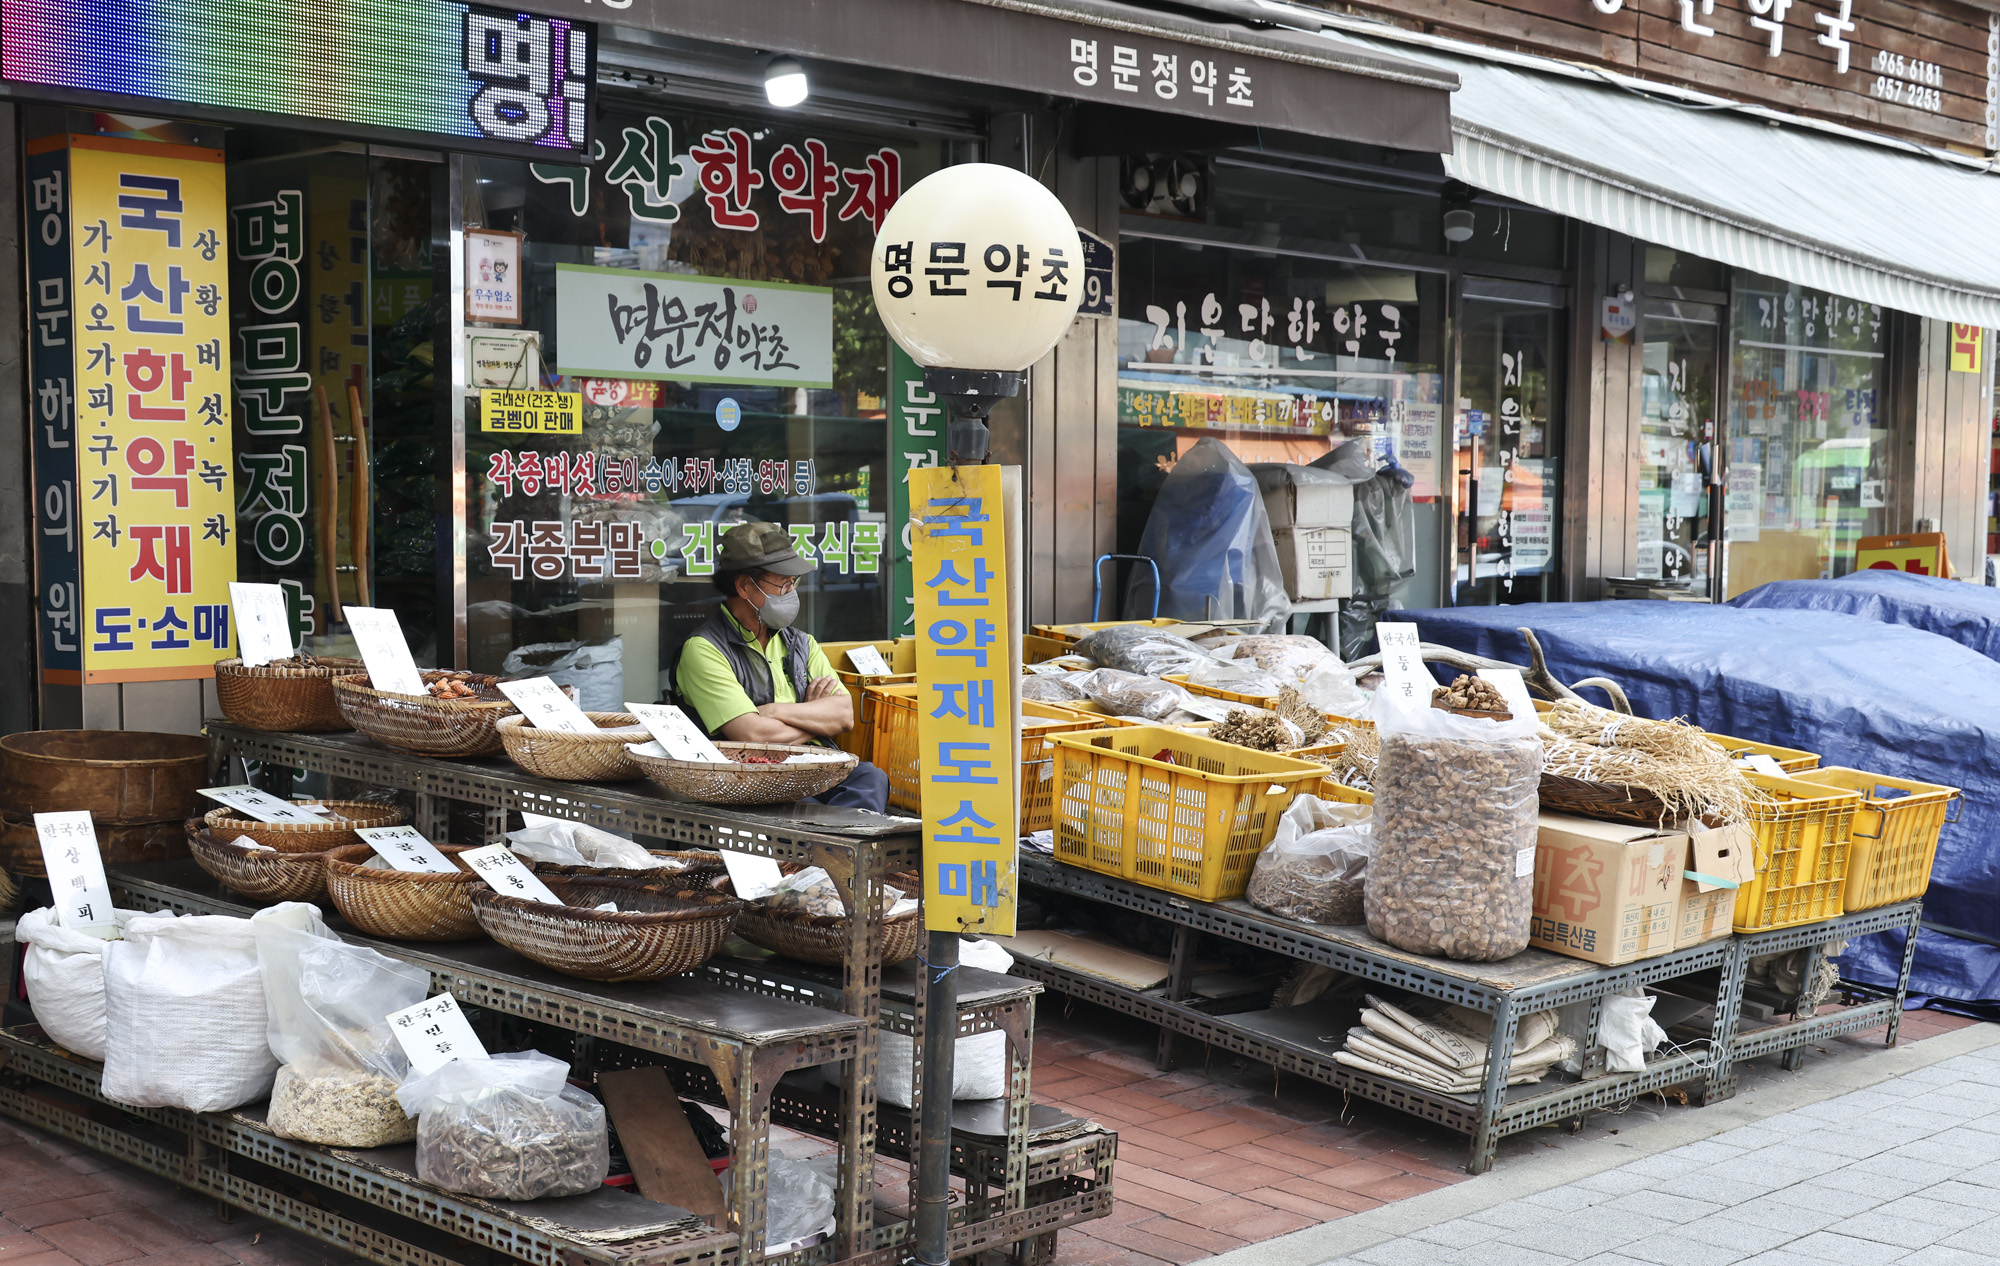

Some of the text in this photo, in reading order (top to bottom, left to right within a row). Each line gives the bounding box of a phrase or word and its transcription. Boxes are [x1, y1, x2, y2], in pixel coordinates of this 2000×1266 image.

[1070, 38, 1254, 108] 명문정약초
[1878, 50, 1942, 86] 965 6181
[1877, 76, 1941, 112] 957 2253
[883, 240, 1068, 302] 명문약초
[475, 288, 513, 303] 우수업소
[607, 282, 800, 371] 명문정약초
[33, 170, 77, 652] 명문한의원
[490, 409, 575, 431] 굼벵이 판매
[1497, 350, 1523, 606] 지운당한약
[681, 520, 883, 575] 건조식품
[93, 603, 229, 652] 도·소매
[1383, 632, 1417, 646] 한국산
[42, 821, 90, 838] 한국산
[367, 830, 418, 841] 한국산
[474, 852, 517, 871] 한국산
[396, 1000, 453, 1028] 한국산
[425, 1024, 459, 1062] 민들
